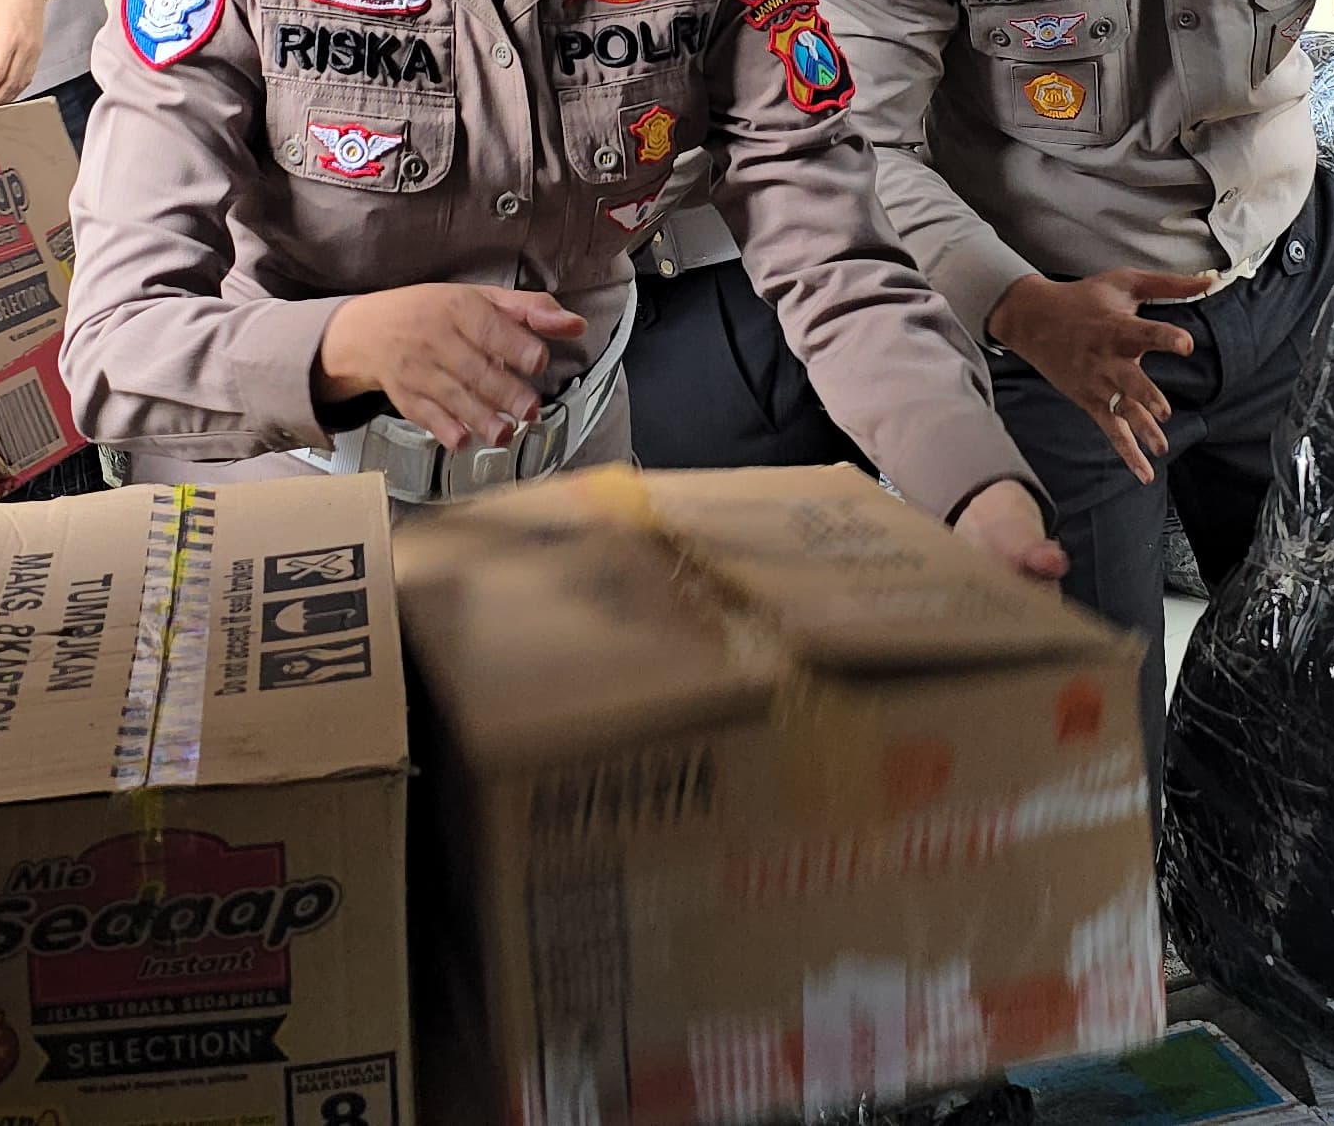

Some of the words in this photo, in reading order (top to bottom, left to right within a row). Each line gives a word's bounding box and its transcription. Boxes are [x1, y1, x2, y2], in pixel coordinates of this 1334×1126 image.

[275, 24, 443, 84] RISKA
[9, 855, 96, 893] Mie
[137, 949, 254, 980] Instant
[321, 1093, 370, 1126] 8
